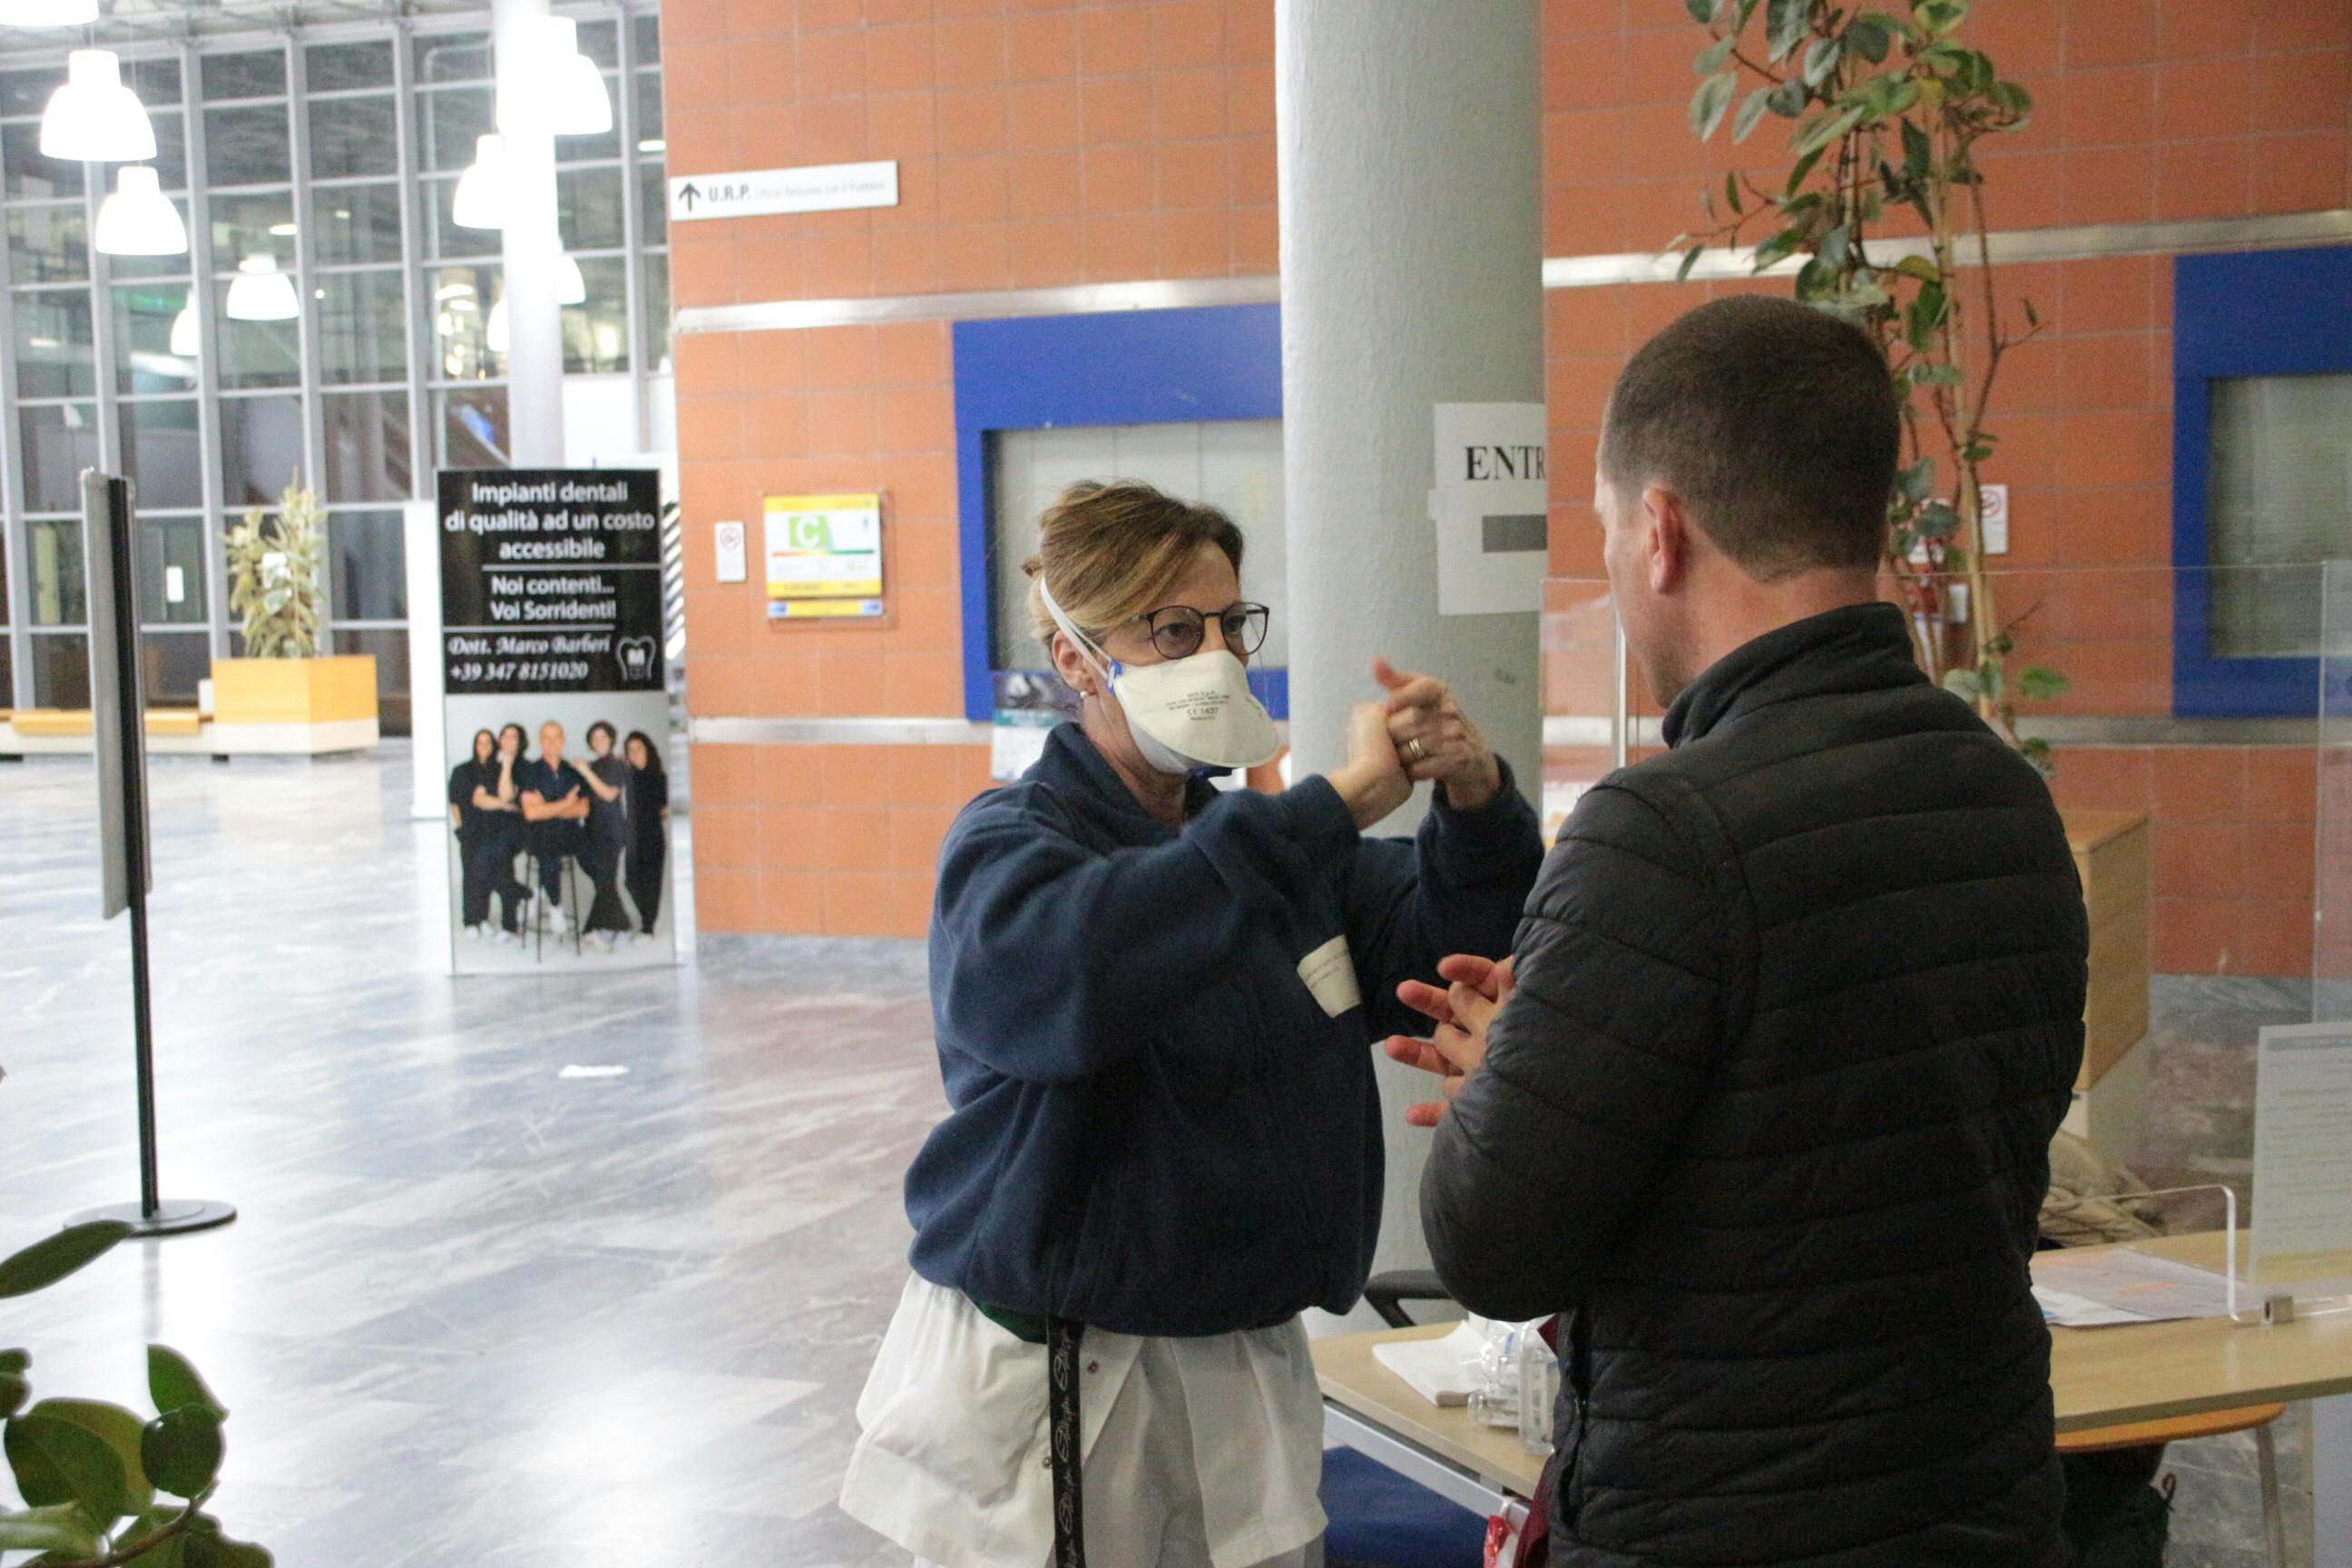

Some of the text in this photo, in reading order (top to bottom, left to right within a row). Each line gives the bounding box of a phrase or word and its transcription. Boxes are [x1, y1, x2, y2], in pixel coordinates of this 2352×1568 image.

[708, 184, 751, 202] U.R.P.
[1465, 446, 1546, 480] ENTR
[472, 481, 628, 505] Impianti dentali
[446, 509, 654, 535] di qualità ad un costo
[499, 538, 605, 559] accessibile
[492, 574, 614, 594] Noi contenti...
[490, 600, 616, 620] Voi Sorridenti!
[448, 637, 492, 654] Dott.
[496, 636, 548, 654] Marco
[451, 663, 481, 681] +39
[485, 662, 516, 680] 347
